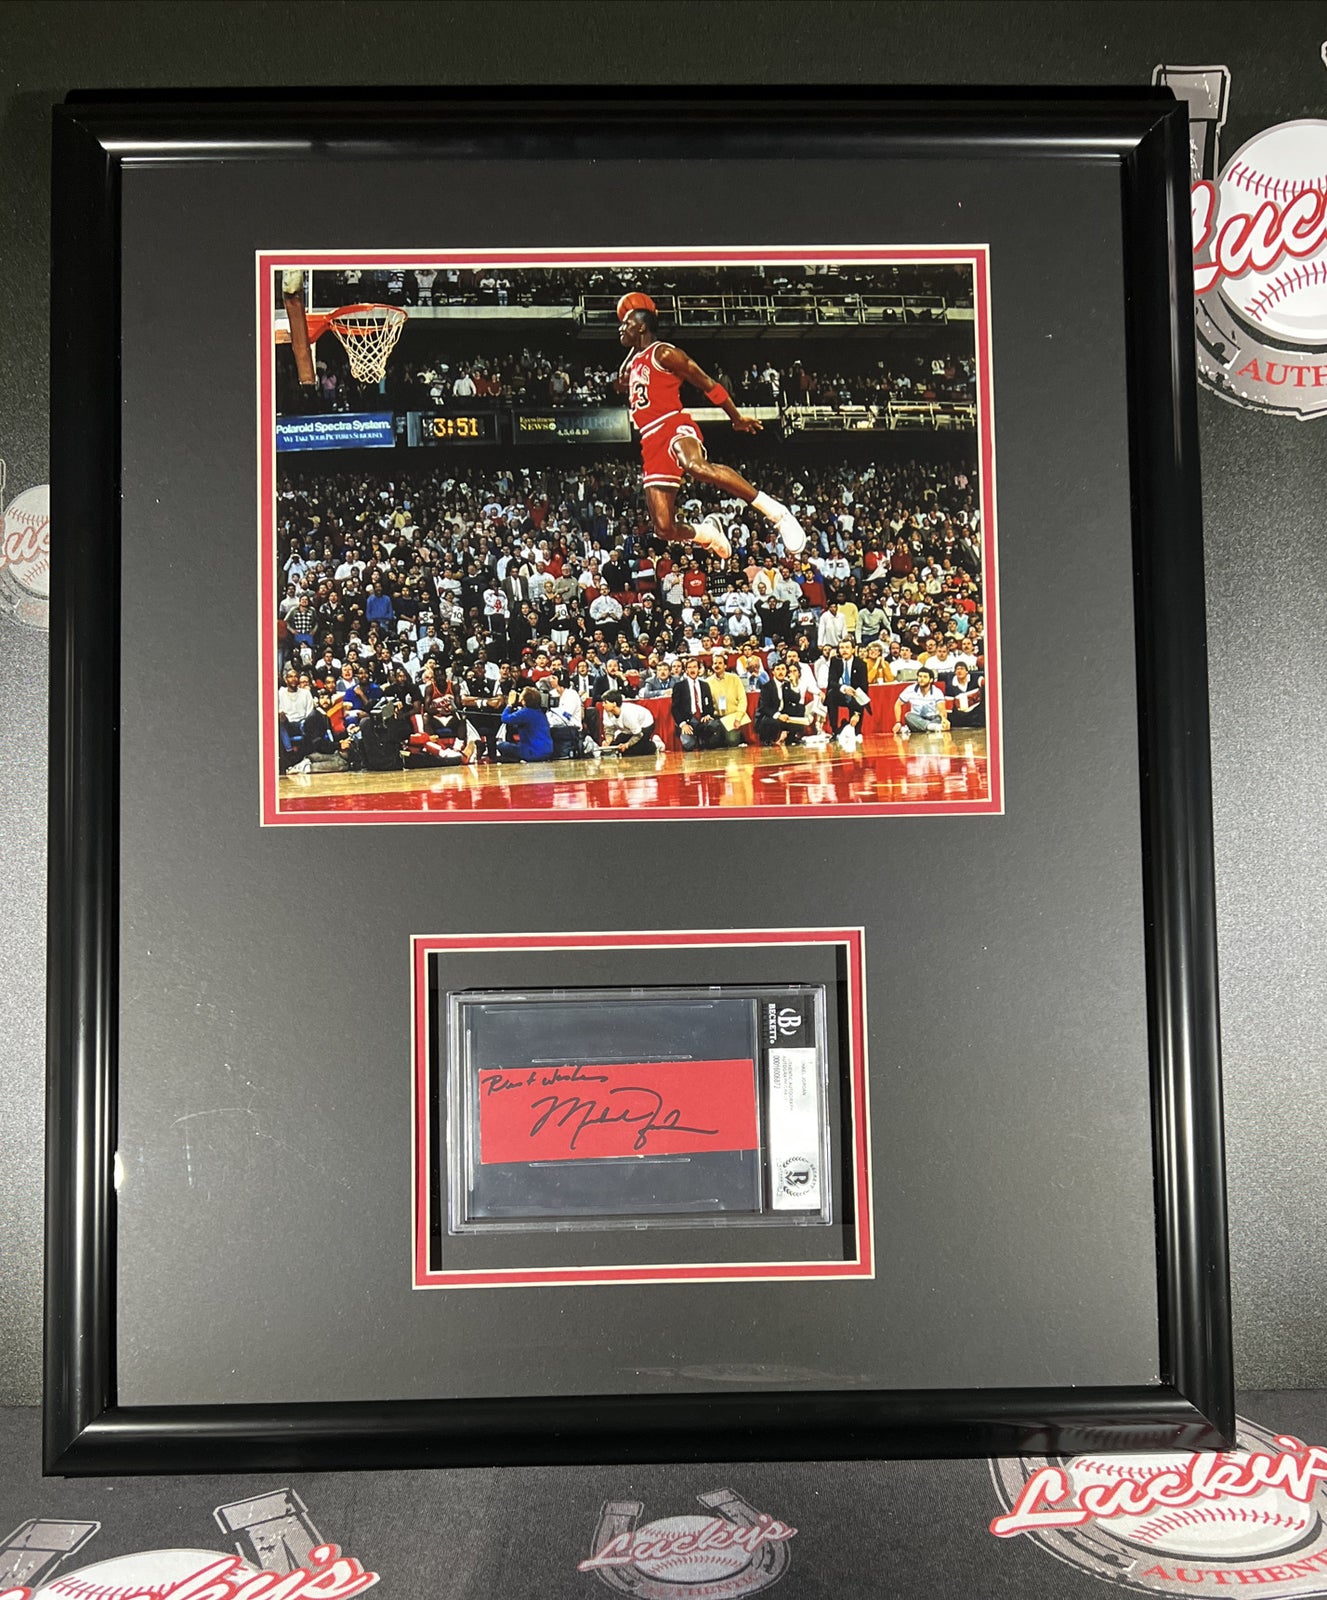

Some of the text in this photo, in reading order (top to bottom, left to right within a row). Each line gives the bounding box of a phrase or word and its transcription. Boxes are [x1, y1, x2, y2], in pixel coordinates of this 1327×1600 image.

[276, 422, 314, 434] Polaroid
[315, 421, 352, 433] Spectra
[433, 417, 479, 437] 3:51
[520, 423, 549, 431] NEWS
[768, 1003, 777, 1041] BECKETT
